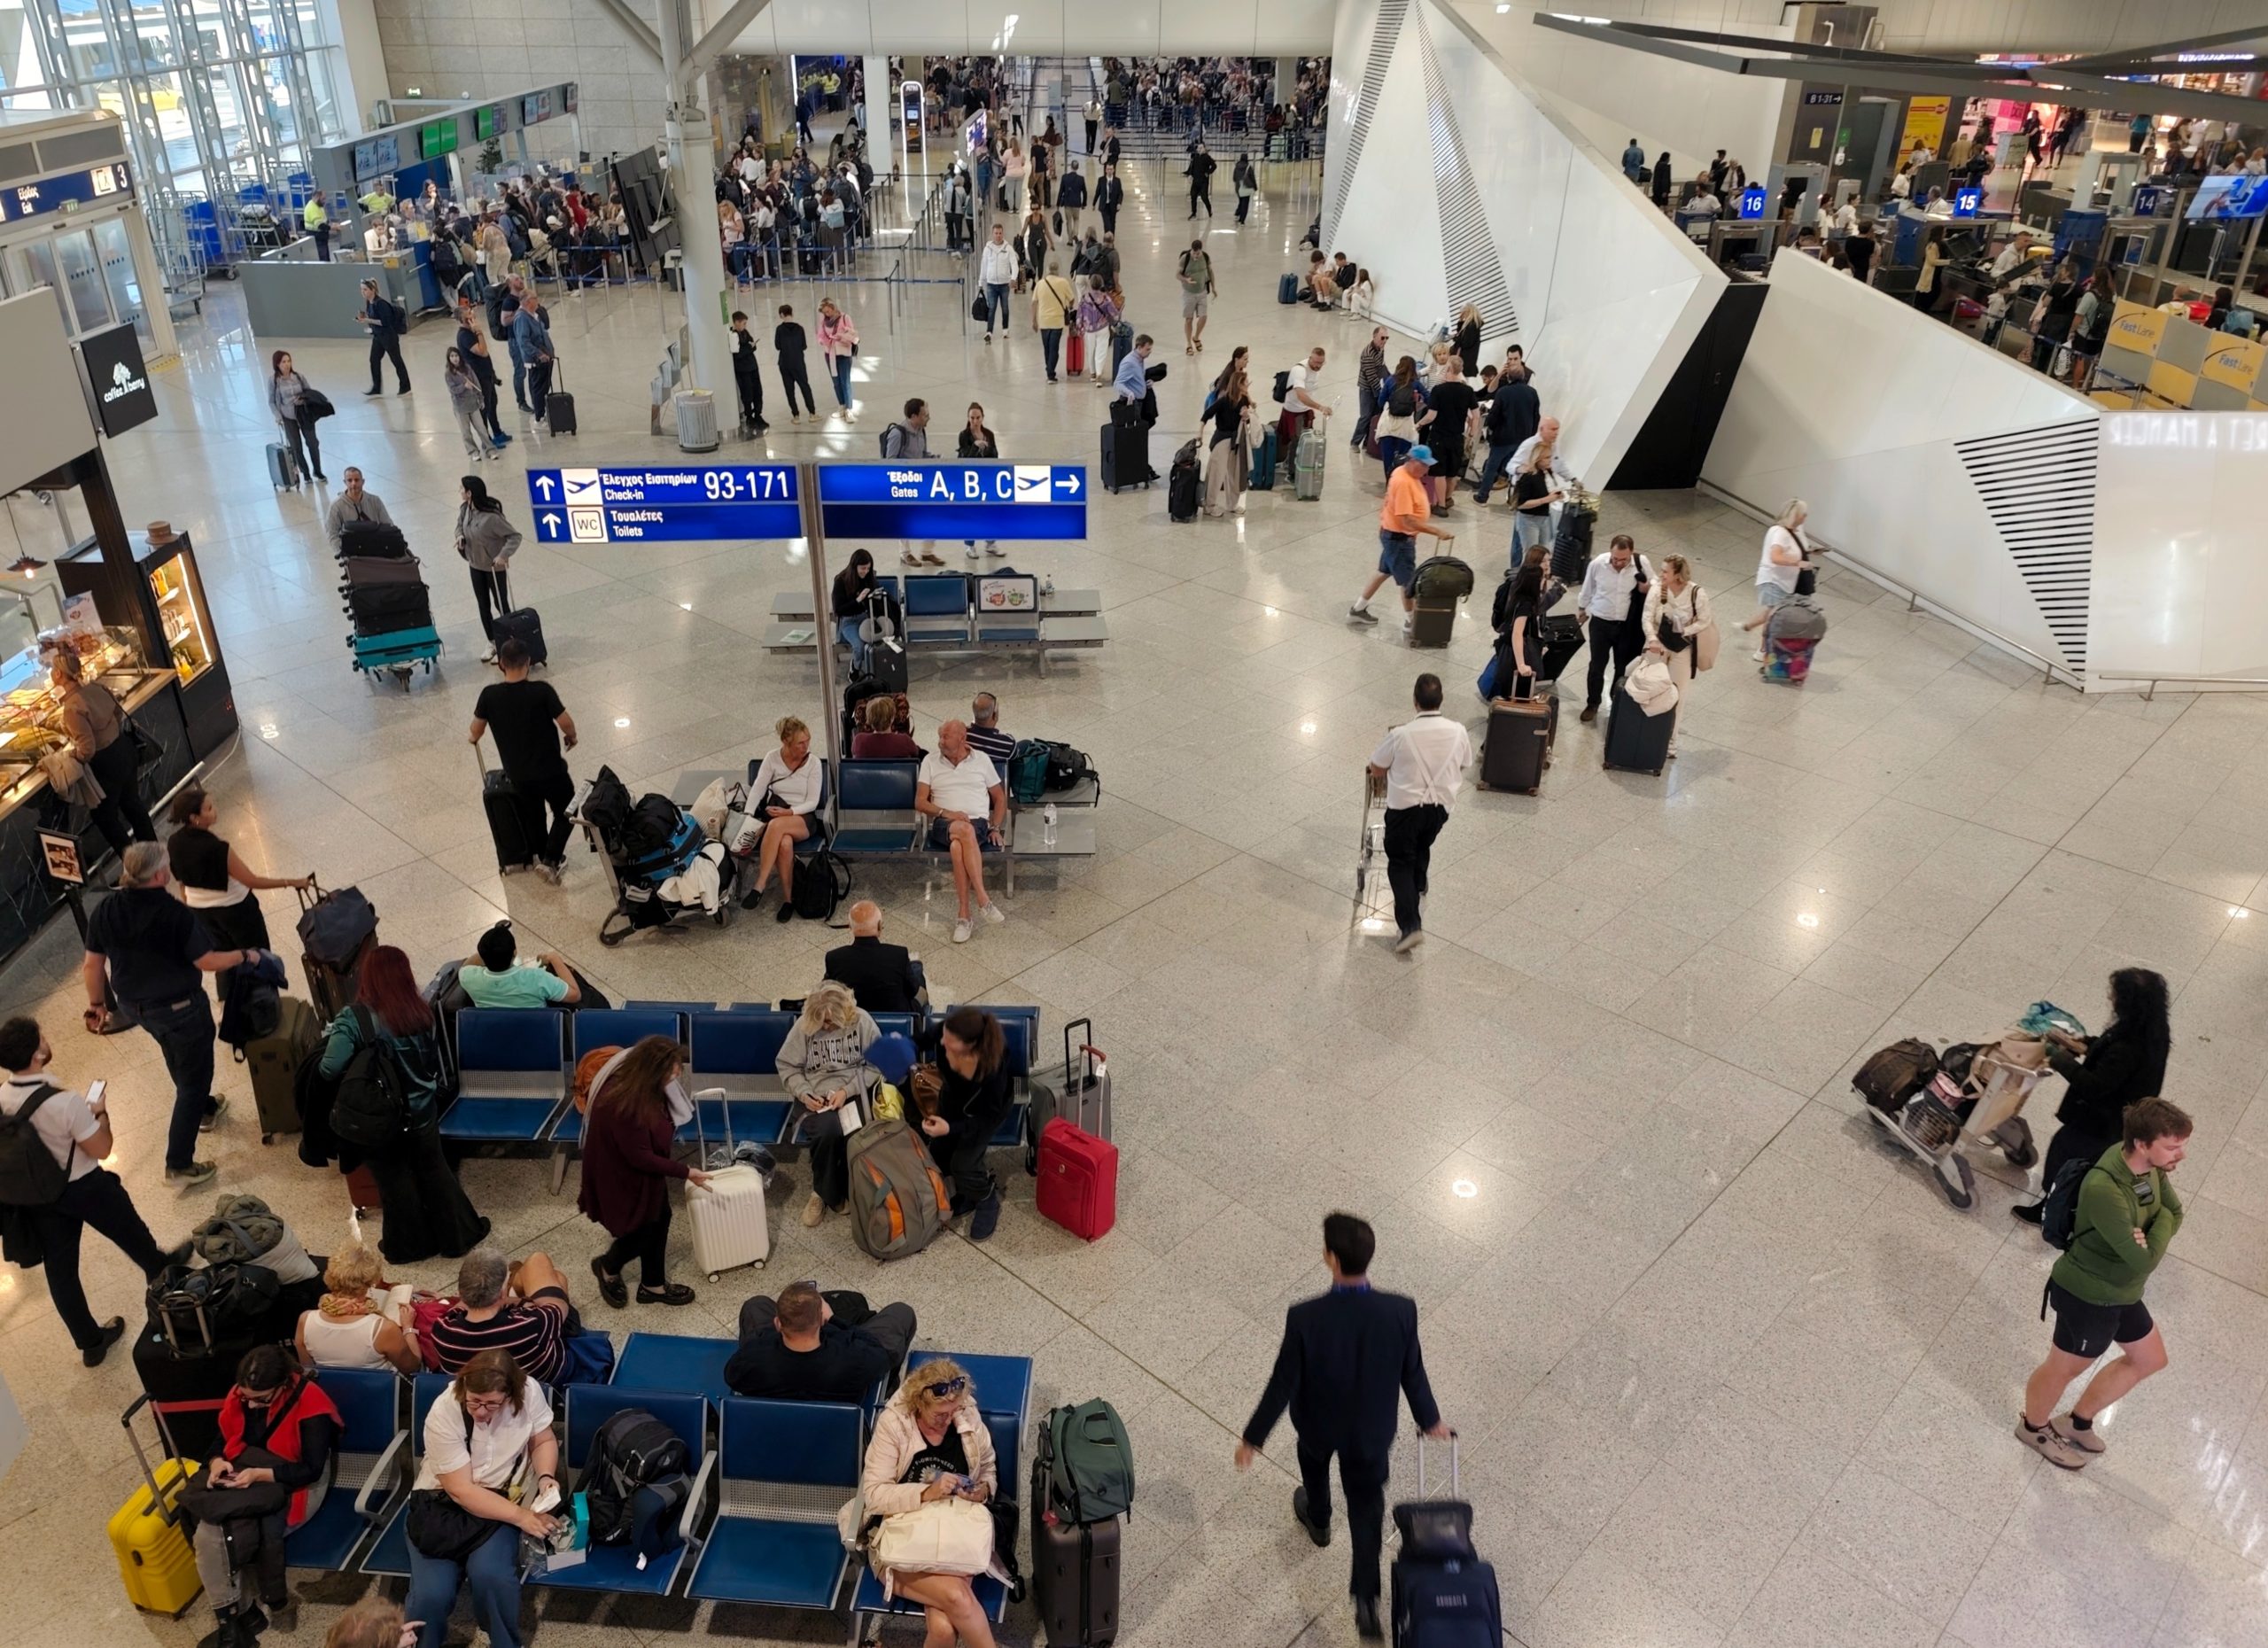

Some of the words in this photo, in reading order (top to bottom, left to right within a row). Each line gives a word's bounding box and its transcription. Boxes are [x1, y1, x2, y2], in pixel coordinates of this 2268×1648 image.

[117, 164, 128, 188] 3
[1746, 196, 1762, 212] 16
[1960, 194, 1977, 210] 15
[2140, 195, 2155, 210] 14
[2119, 319, 2137, 333] Fast
[2137, 324, 2155, 338] Lane
[2218, 354, 2238, 369] Fast
[2237, 361, 2254, 375] Lane
[104, 386, 124, 403] coffee
[127, 377, 145, 392] berry
[599, 473, 644, 487] Έλεγχος
[645, 472, 697, 486] Εισιτηρίων
[703, 470, 788, 499] 93-171
[887, 470, 923, 485] Έξοδοι
[891, 486, 919, 498] Gates
[929, 470, 955, 501] A,
[964, 470, 987, 501] B,
[996, 470, 1012, 499] C
[604, 489, 644, 501] Check-in
[610, 509, 664, 524] Τουαλέτες
[577, 518, 598, 531] WC
[612, 525, 643, 537] Toilets
